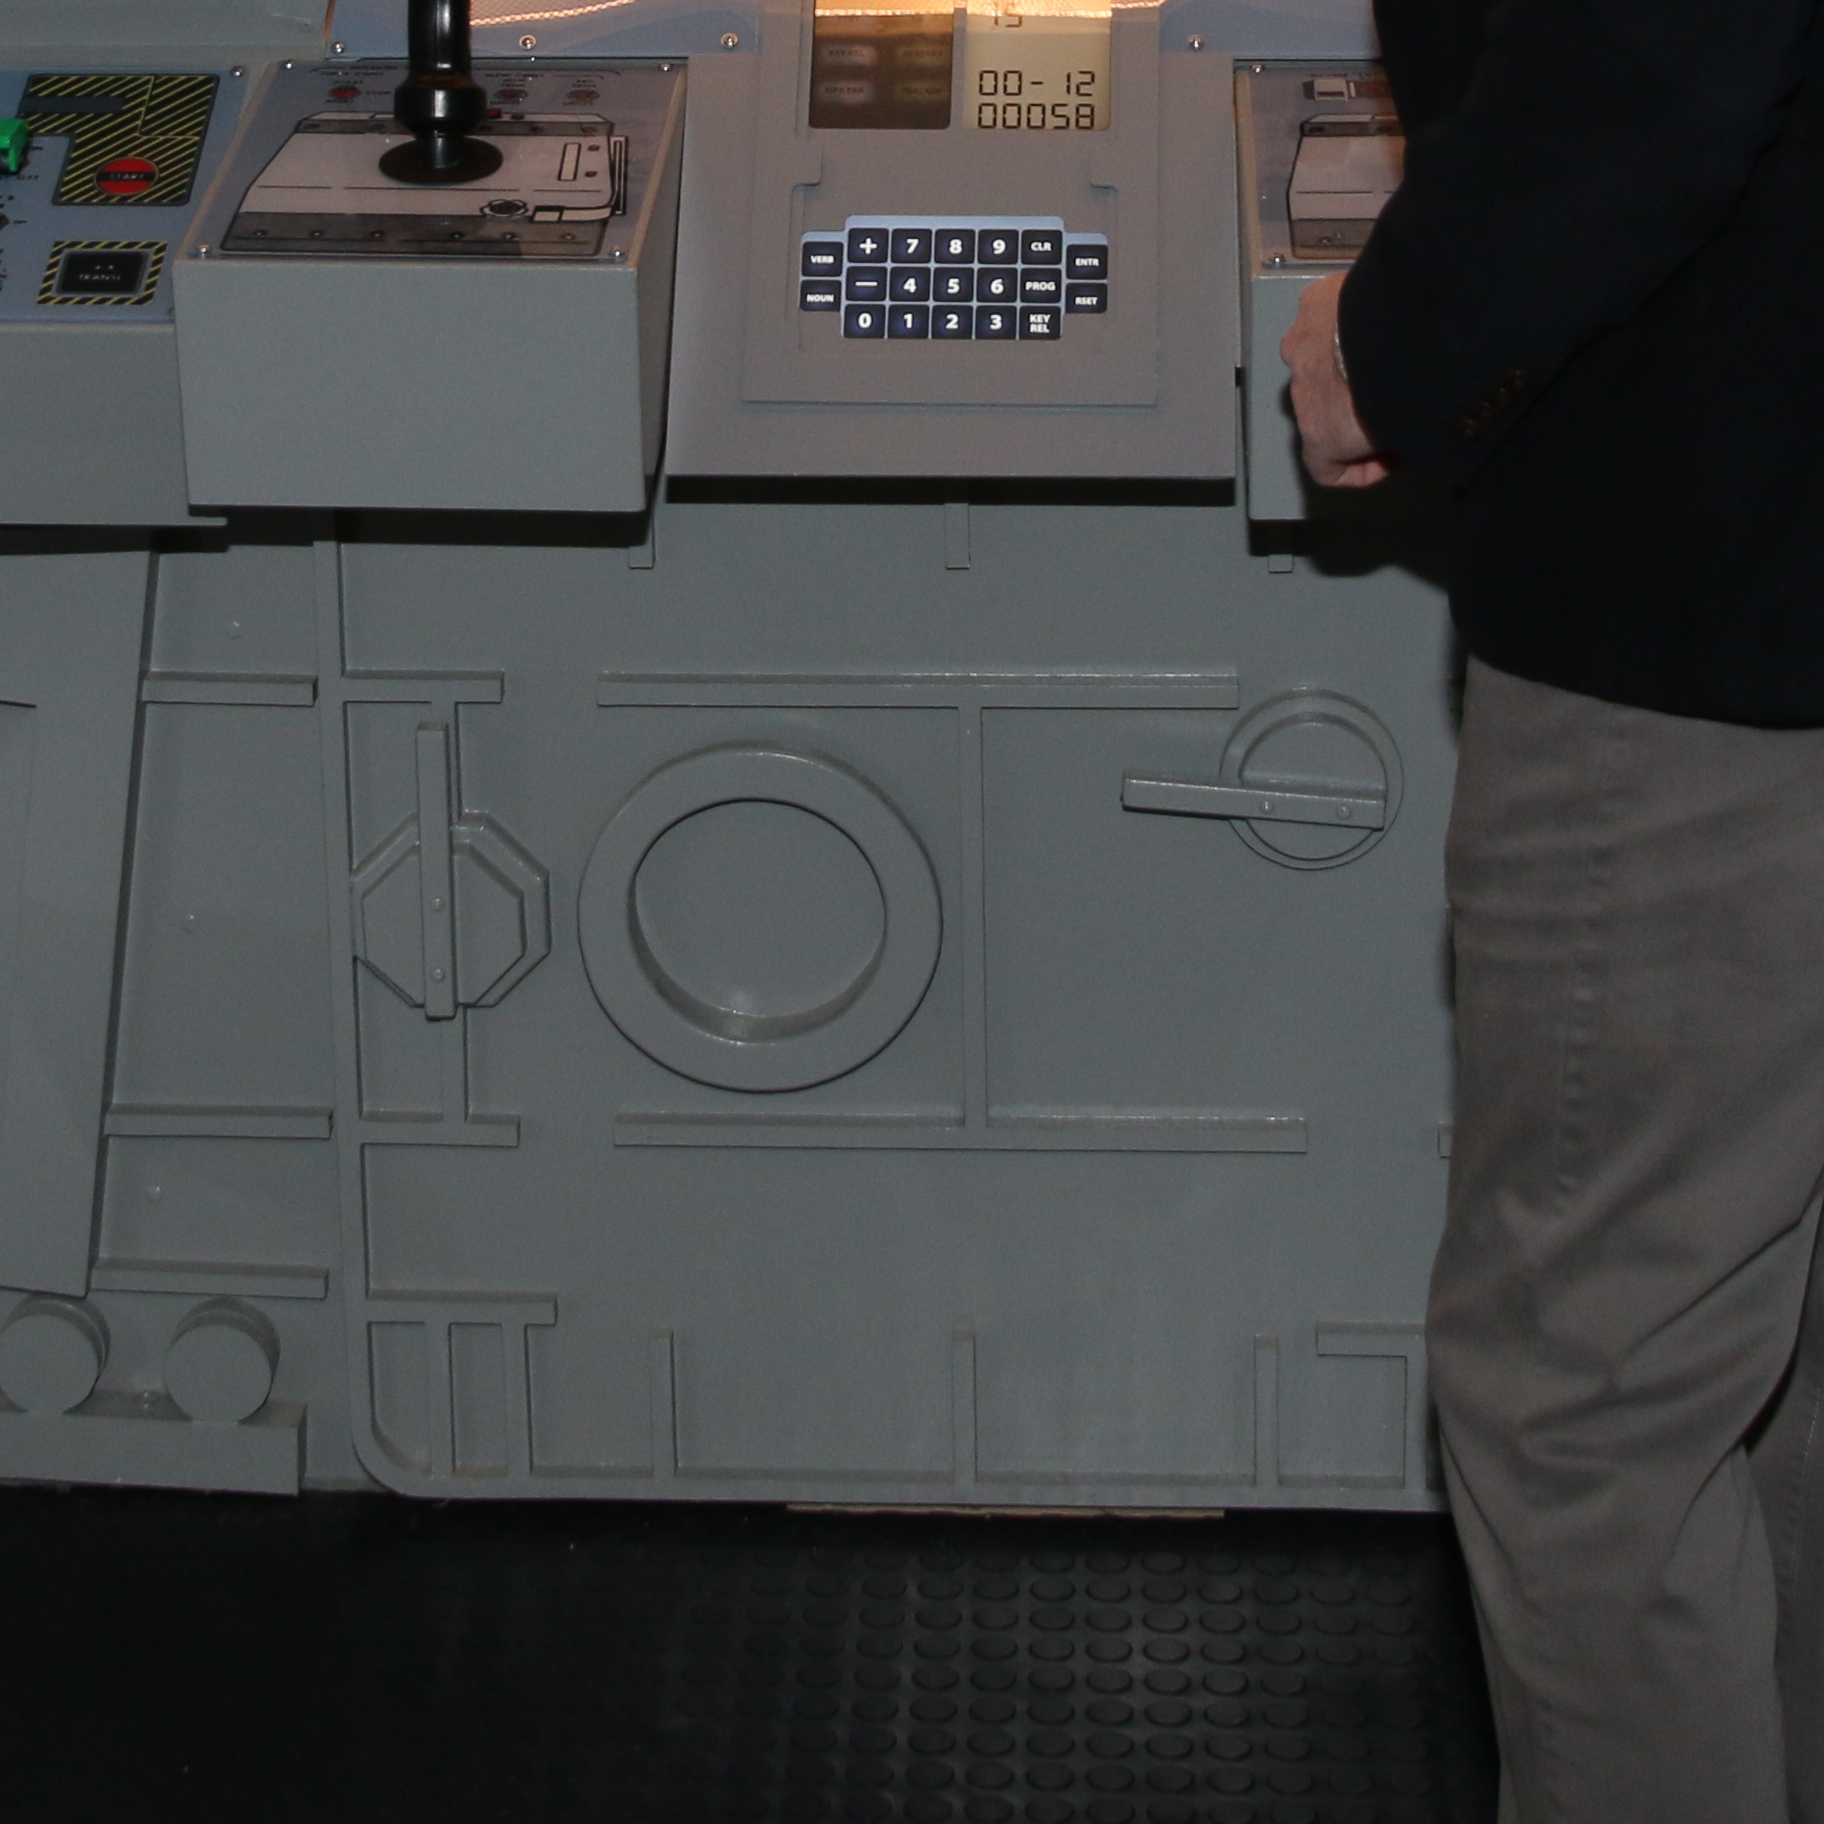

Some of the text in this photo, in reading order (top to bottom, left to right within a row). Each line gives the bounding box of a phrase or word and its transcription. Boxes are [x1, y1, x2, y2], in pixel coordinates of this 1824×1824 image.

[977, 102, 1095, 130] 00058
[110, 172, 145, 180] START
[905, 238, 919, 254] 7
[949, 238, 962, 255] 8
[992, 238, 1006, 255] 9
[1030, 241, 1052, 253] CLR
[810, 255, 834, 264] VERB
[1075, 258, 1099, 267] ENTR
[903, 277, 917, 293] 4
[947, 278, 960, 294] 5
[990, 278, 1004, 294] 6
[1025, 281, 1056, 292] PROG
[806, 294, 834, 303] NOUN
[1075, 296, 1098, 305] RSET
[858, 313, 873, 329] 0
[903, 313, 913, 329] 1
[945, 313, 959, 329] 2
[990, 314, 1003, 330] 3
[1029, 314, 1051, 323] KEY
[1030, 323, 1050, 334] REL
